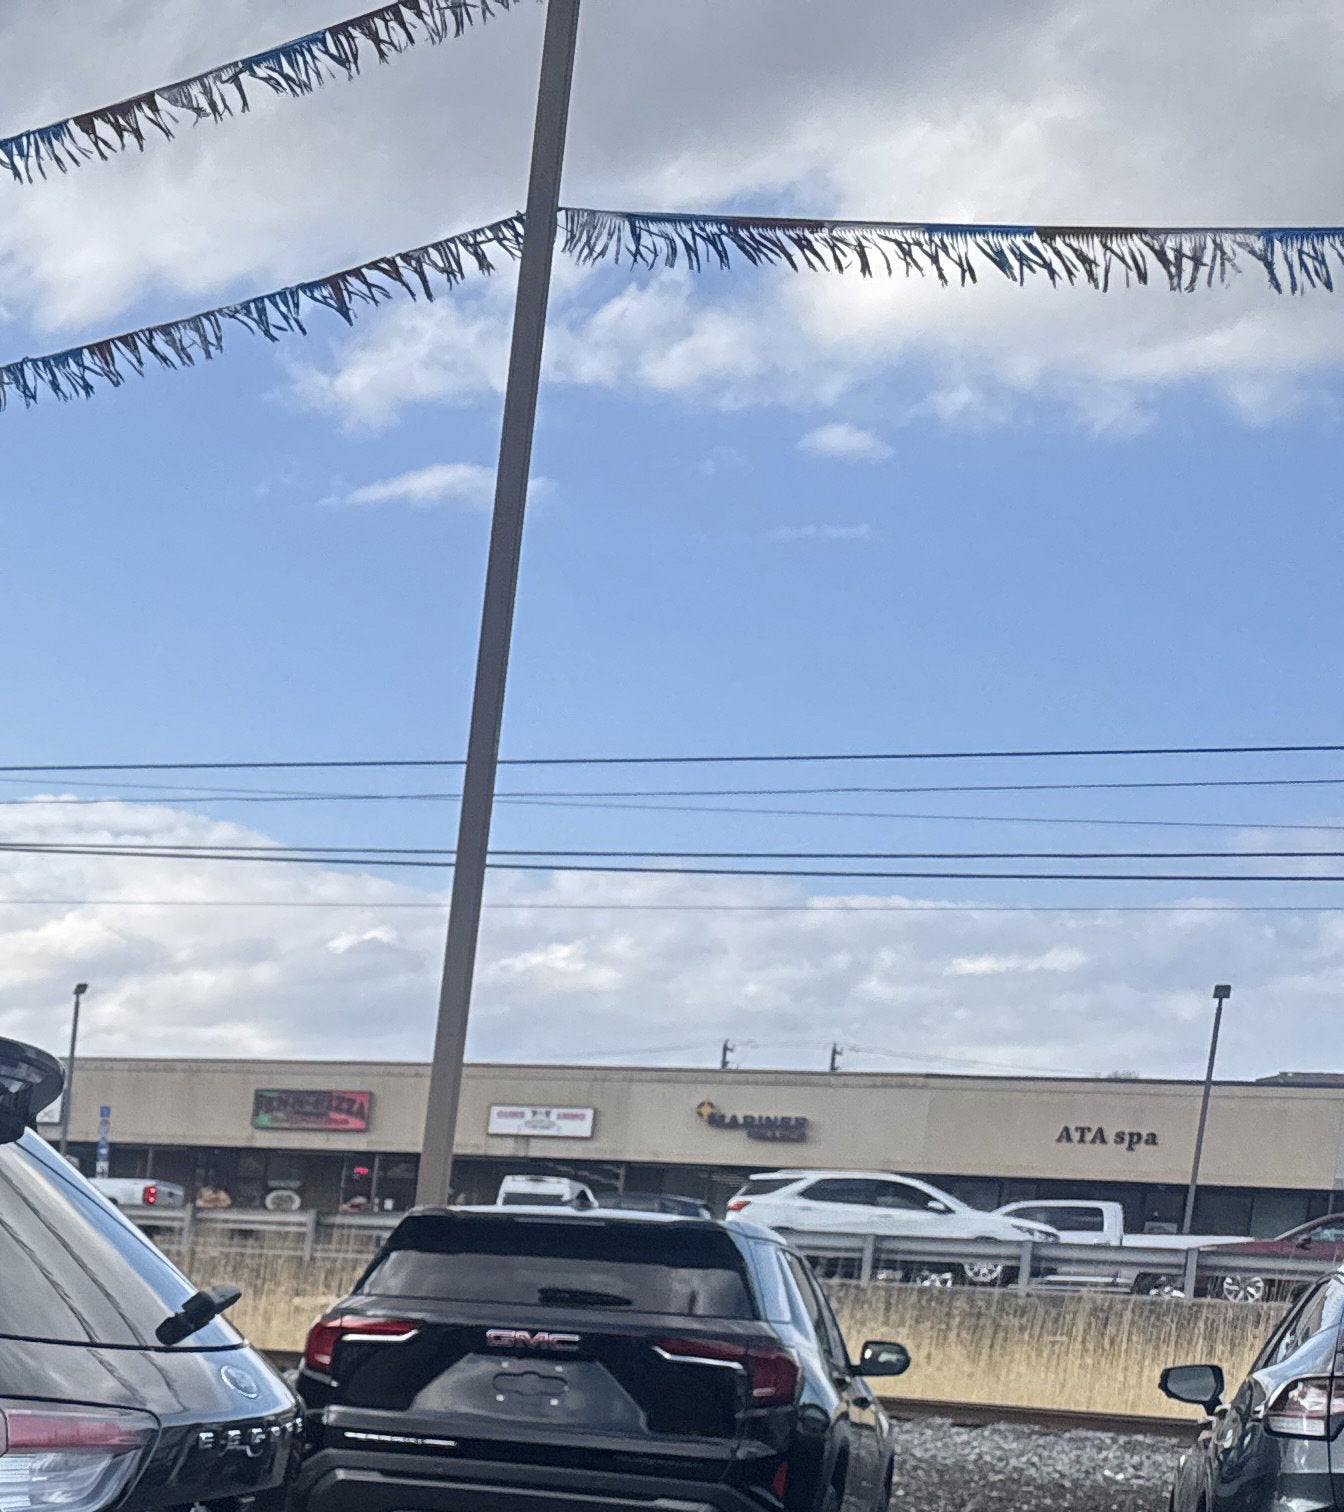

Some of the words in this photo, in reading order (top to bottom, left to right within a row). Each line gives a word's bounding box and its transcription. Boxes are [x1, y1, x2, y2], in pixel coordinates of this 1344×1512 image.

[1056, 1126, 1108, 1145] ATA
[1114, 1130, 1158, 1152] spa
[486, 1328, 581, 1351] GMC
